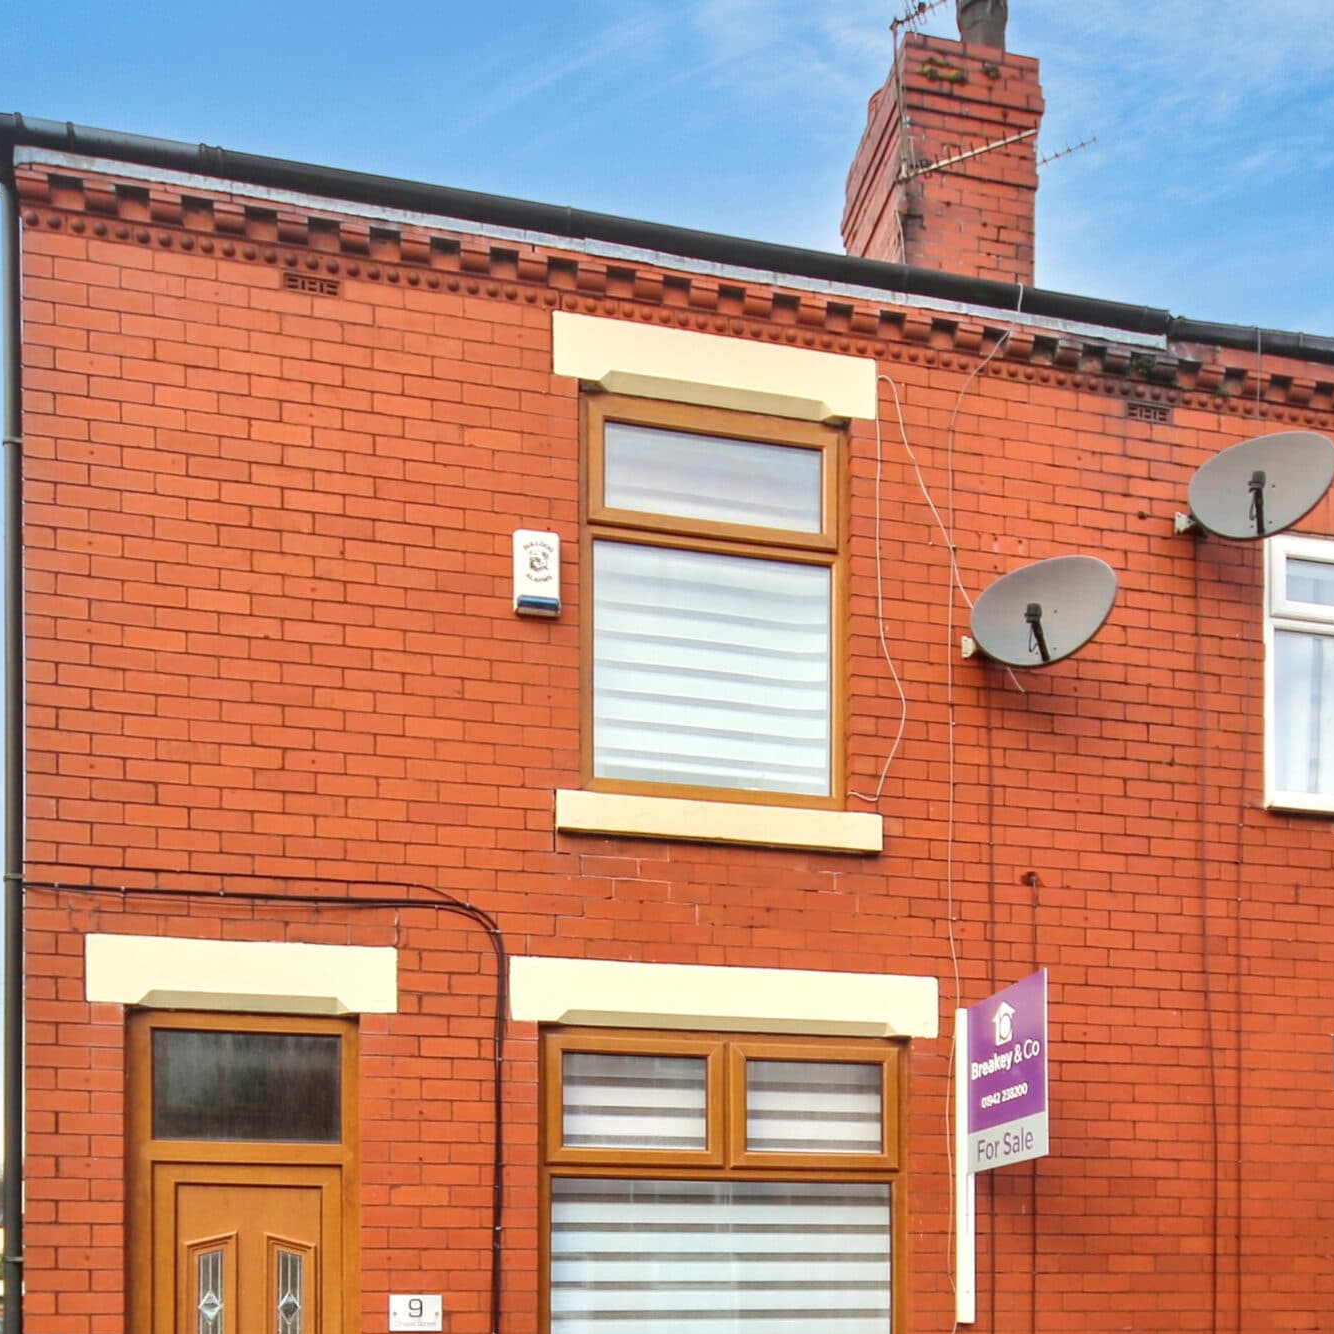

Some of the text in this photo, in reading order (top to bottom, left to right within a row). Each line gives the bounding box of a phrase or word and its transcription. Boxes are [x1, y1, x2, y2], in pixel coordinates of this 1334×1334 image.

[971, 1039, 1041, 1080] Breakey & Co
[977, 1128, 1034, 1163] For Sale
[408, 1298, 423, 1318] 9
